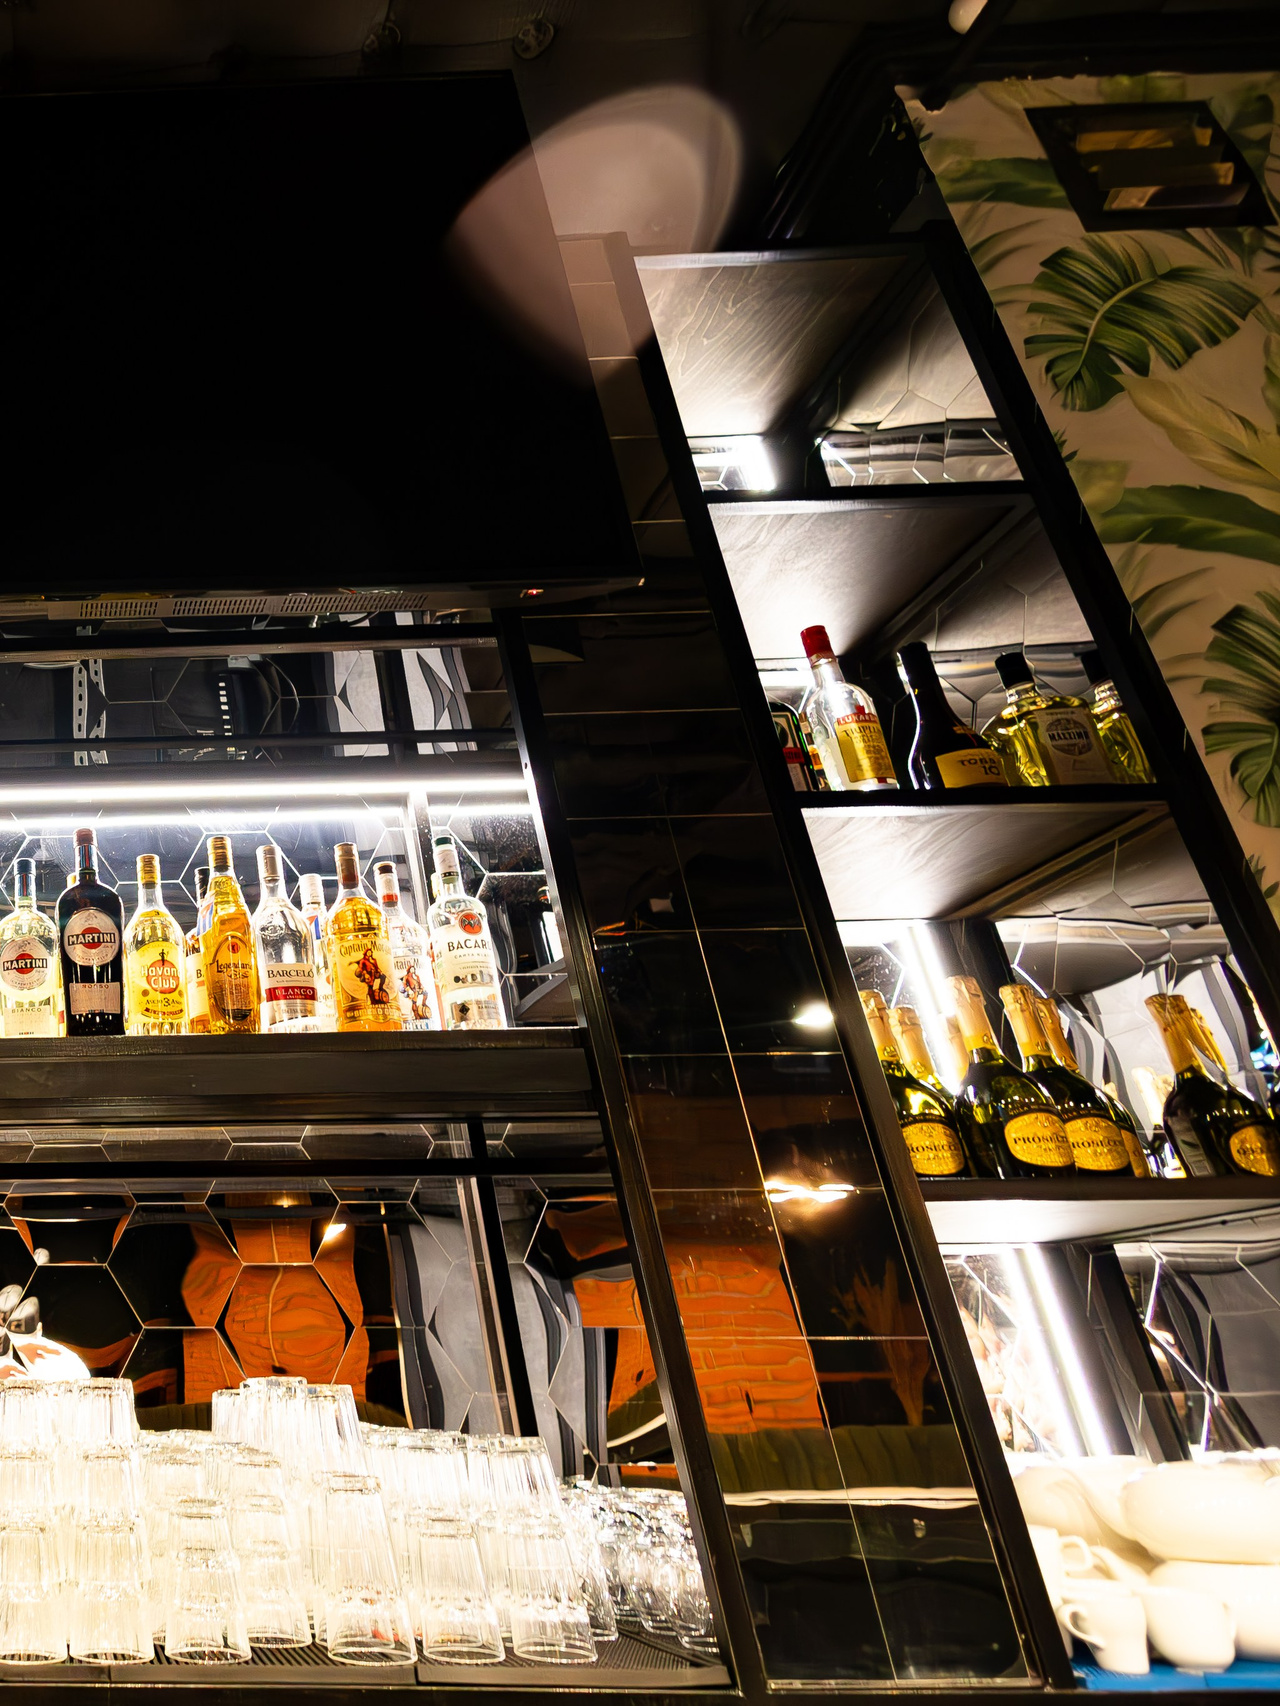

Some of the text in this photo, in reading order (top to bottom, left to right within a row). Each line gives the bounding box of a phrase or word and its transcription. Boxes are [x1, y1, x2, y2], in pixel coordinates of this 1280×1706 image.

[983, 765, 1000, 776] 10
[69, 933, 115, 945] MARTINI
[339, 940, 368, 957] Captain
[3, 959, 47, 970] MARTINI
[267, 968, 314, 979] BARCELÓ
[151, 977, 176, 989] Club
[275, 988, 313, 996] BLANCO
